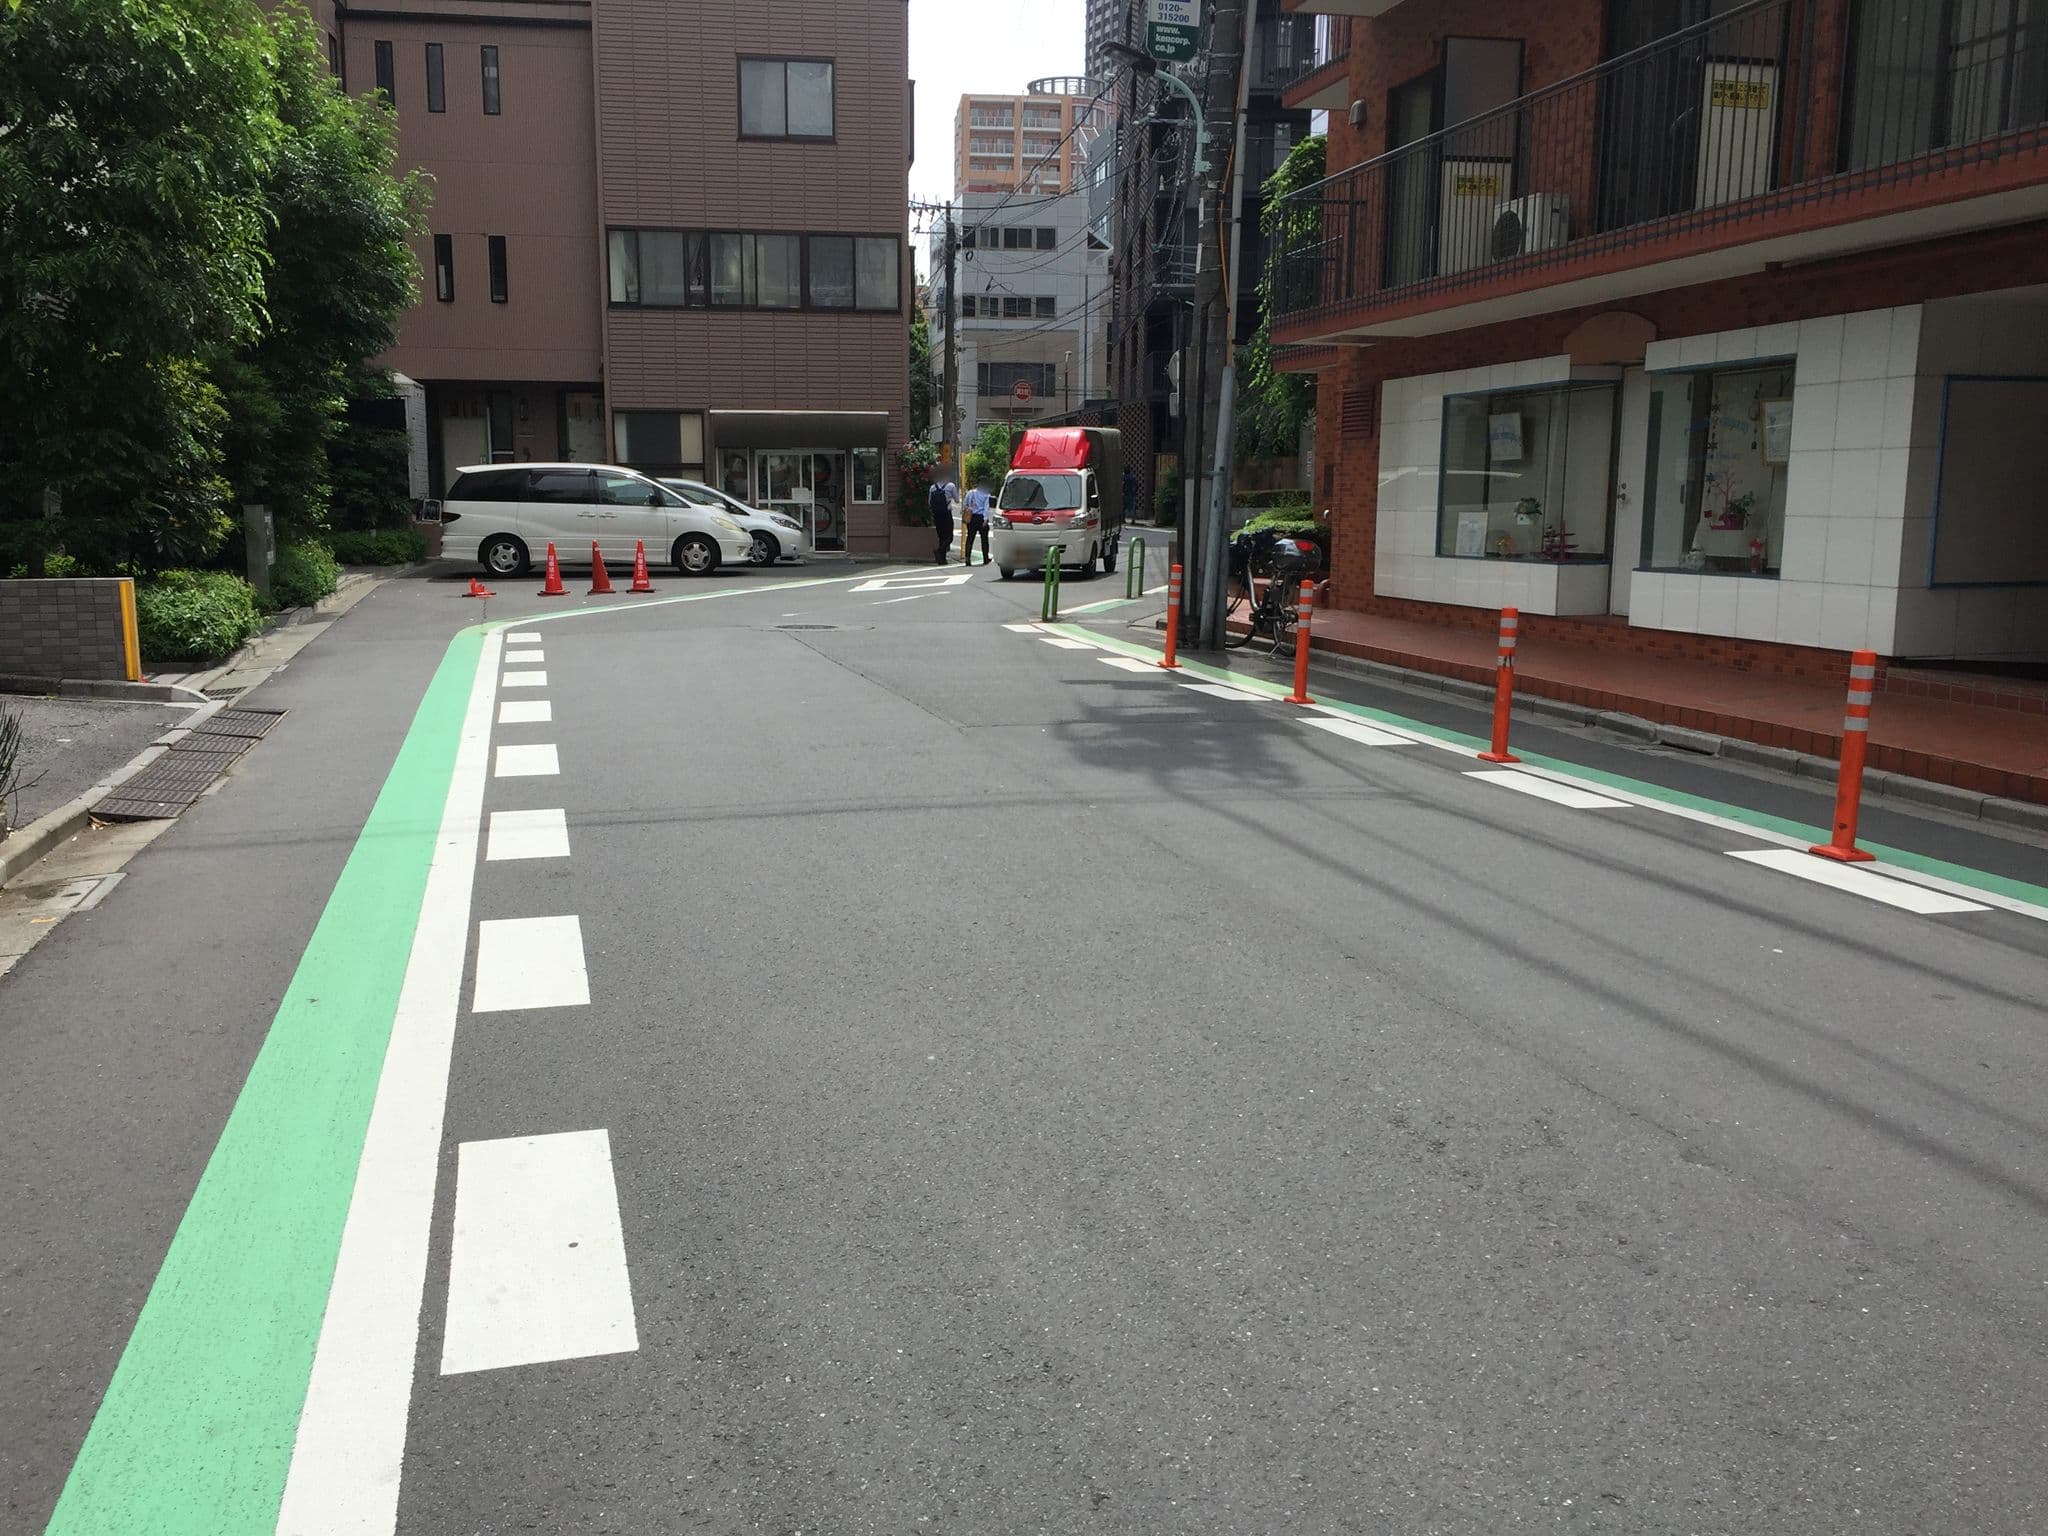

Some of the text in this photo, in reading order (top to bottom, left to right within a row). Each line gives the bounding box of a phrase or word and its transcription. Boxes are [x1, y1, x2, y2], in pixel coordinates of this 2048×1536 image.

[1158, 2, 1184, 12] 0120-
[1157, 12, 1190, 23] 315200
[1156, 26, 1180, 35] www.
[1155, 33, 1191, 46] kencorp.
[1154, 44, 1176, 54] co.jp
